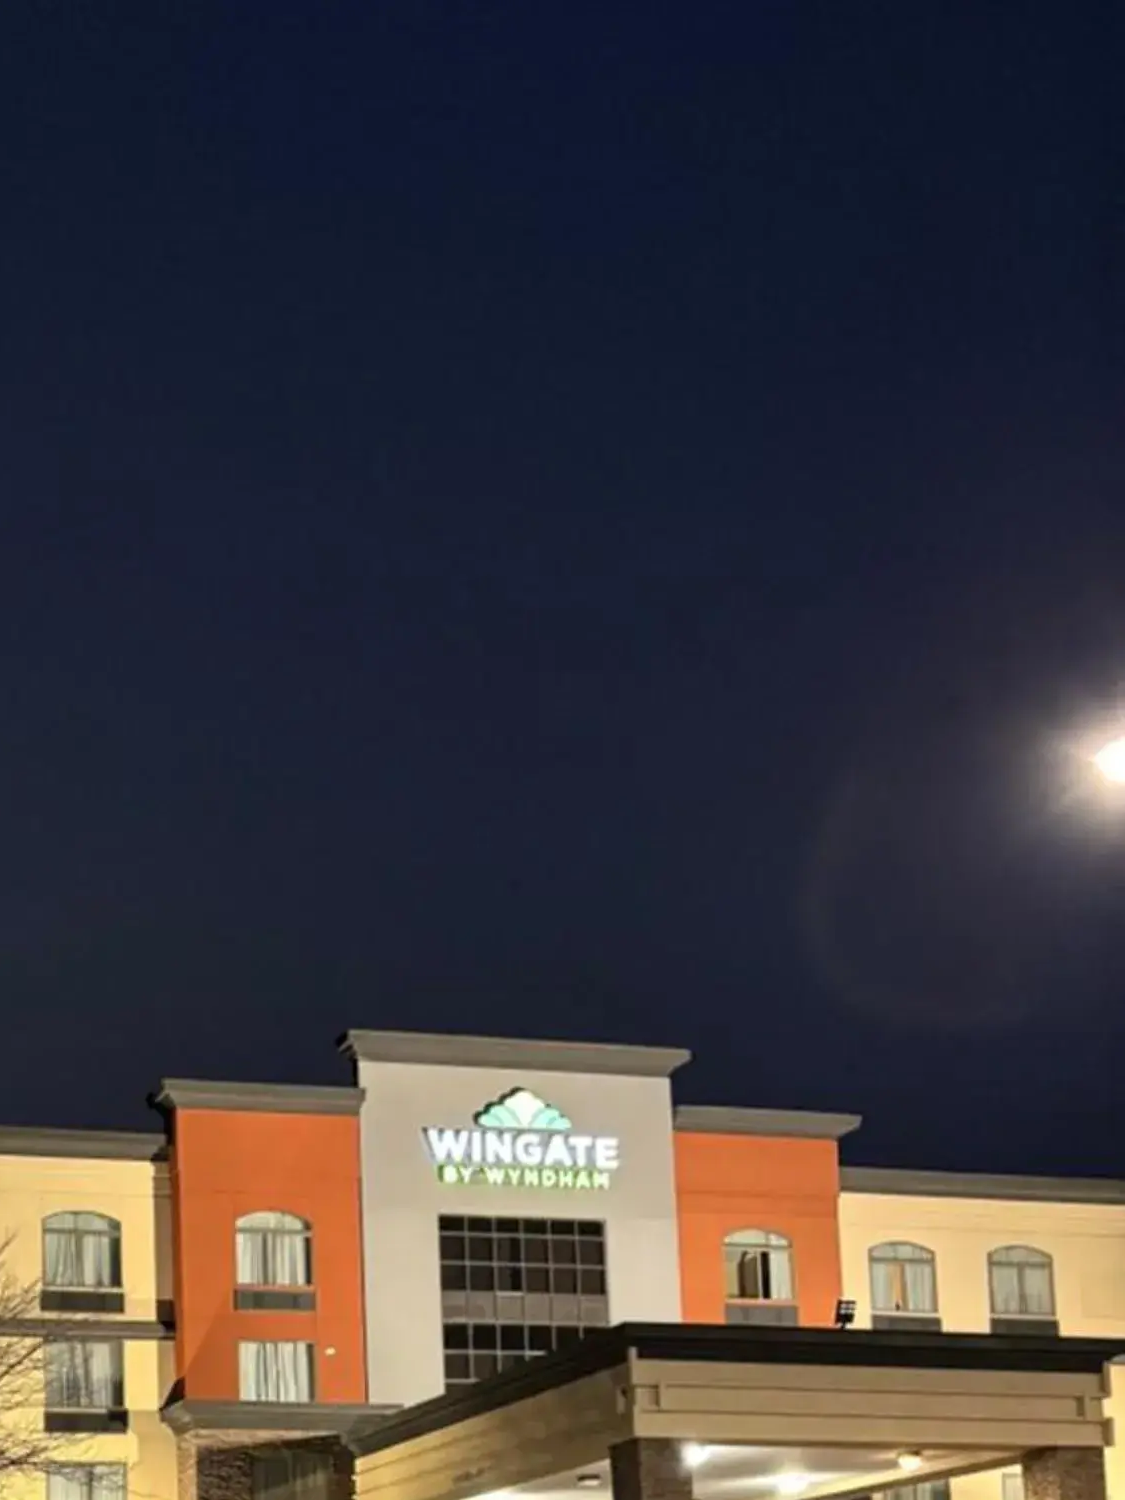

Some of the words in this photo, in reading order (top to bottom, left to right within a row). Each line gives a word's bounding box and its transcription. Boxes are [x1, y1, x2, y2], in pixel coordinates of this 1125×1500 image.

[424, 1126, 620, 1169] WINGATE
[437, 1164, 470, 1184] BY
[479, 1165, 611, 1190] WYNDHAM
